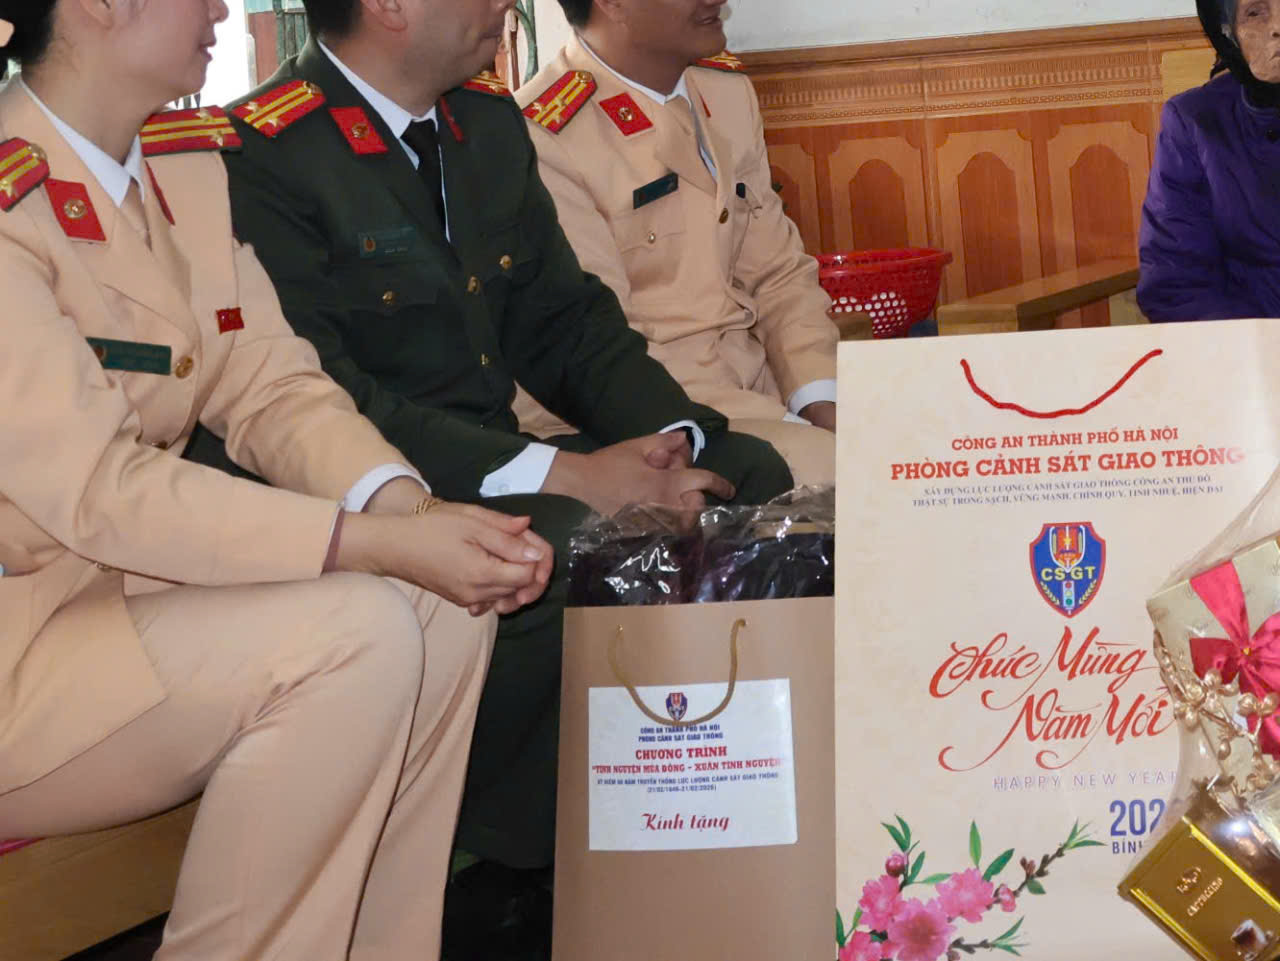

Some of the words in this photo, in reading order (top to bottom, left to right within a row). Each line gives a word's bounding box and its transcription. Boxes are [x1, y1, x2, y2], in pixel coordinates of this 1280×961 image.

[951, 434, 998, 451] CÔNG
[1001, 435, 1024, 449] AN
[1027, 430, 1083, 448] THÀNH
[1087, 425, 1120, 444] PHỐ
[1123, 426, 1147, 442] HÀ
[1150, 425, 1179, 441] NỘI
[890, 457, 969, 480] PHÒNG
[976, 451, 1041, 476] CẢNH
[1048, 449, 1092, 473] SÁT
[1098, 451, 1157, 471] GIAO
[1162, 444, 1246, 468] THÔNG
[1041, 566, 1096, 581] CSGT
[929, 631, 1042, 699] Chúc
[686, 744, 728, 758] TRÌNH
[993, 775, 1062, 791] HAPPY
[1074, 773, 1117, 787] NEW
[641, 813, 683, 832] Kính
[690, 813, 731, 833] tặng
[1110, 798, 1166, 837] 202
[1112, 838, 1143, 855] BÍN
